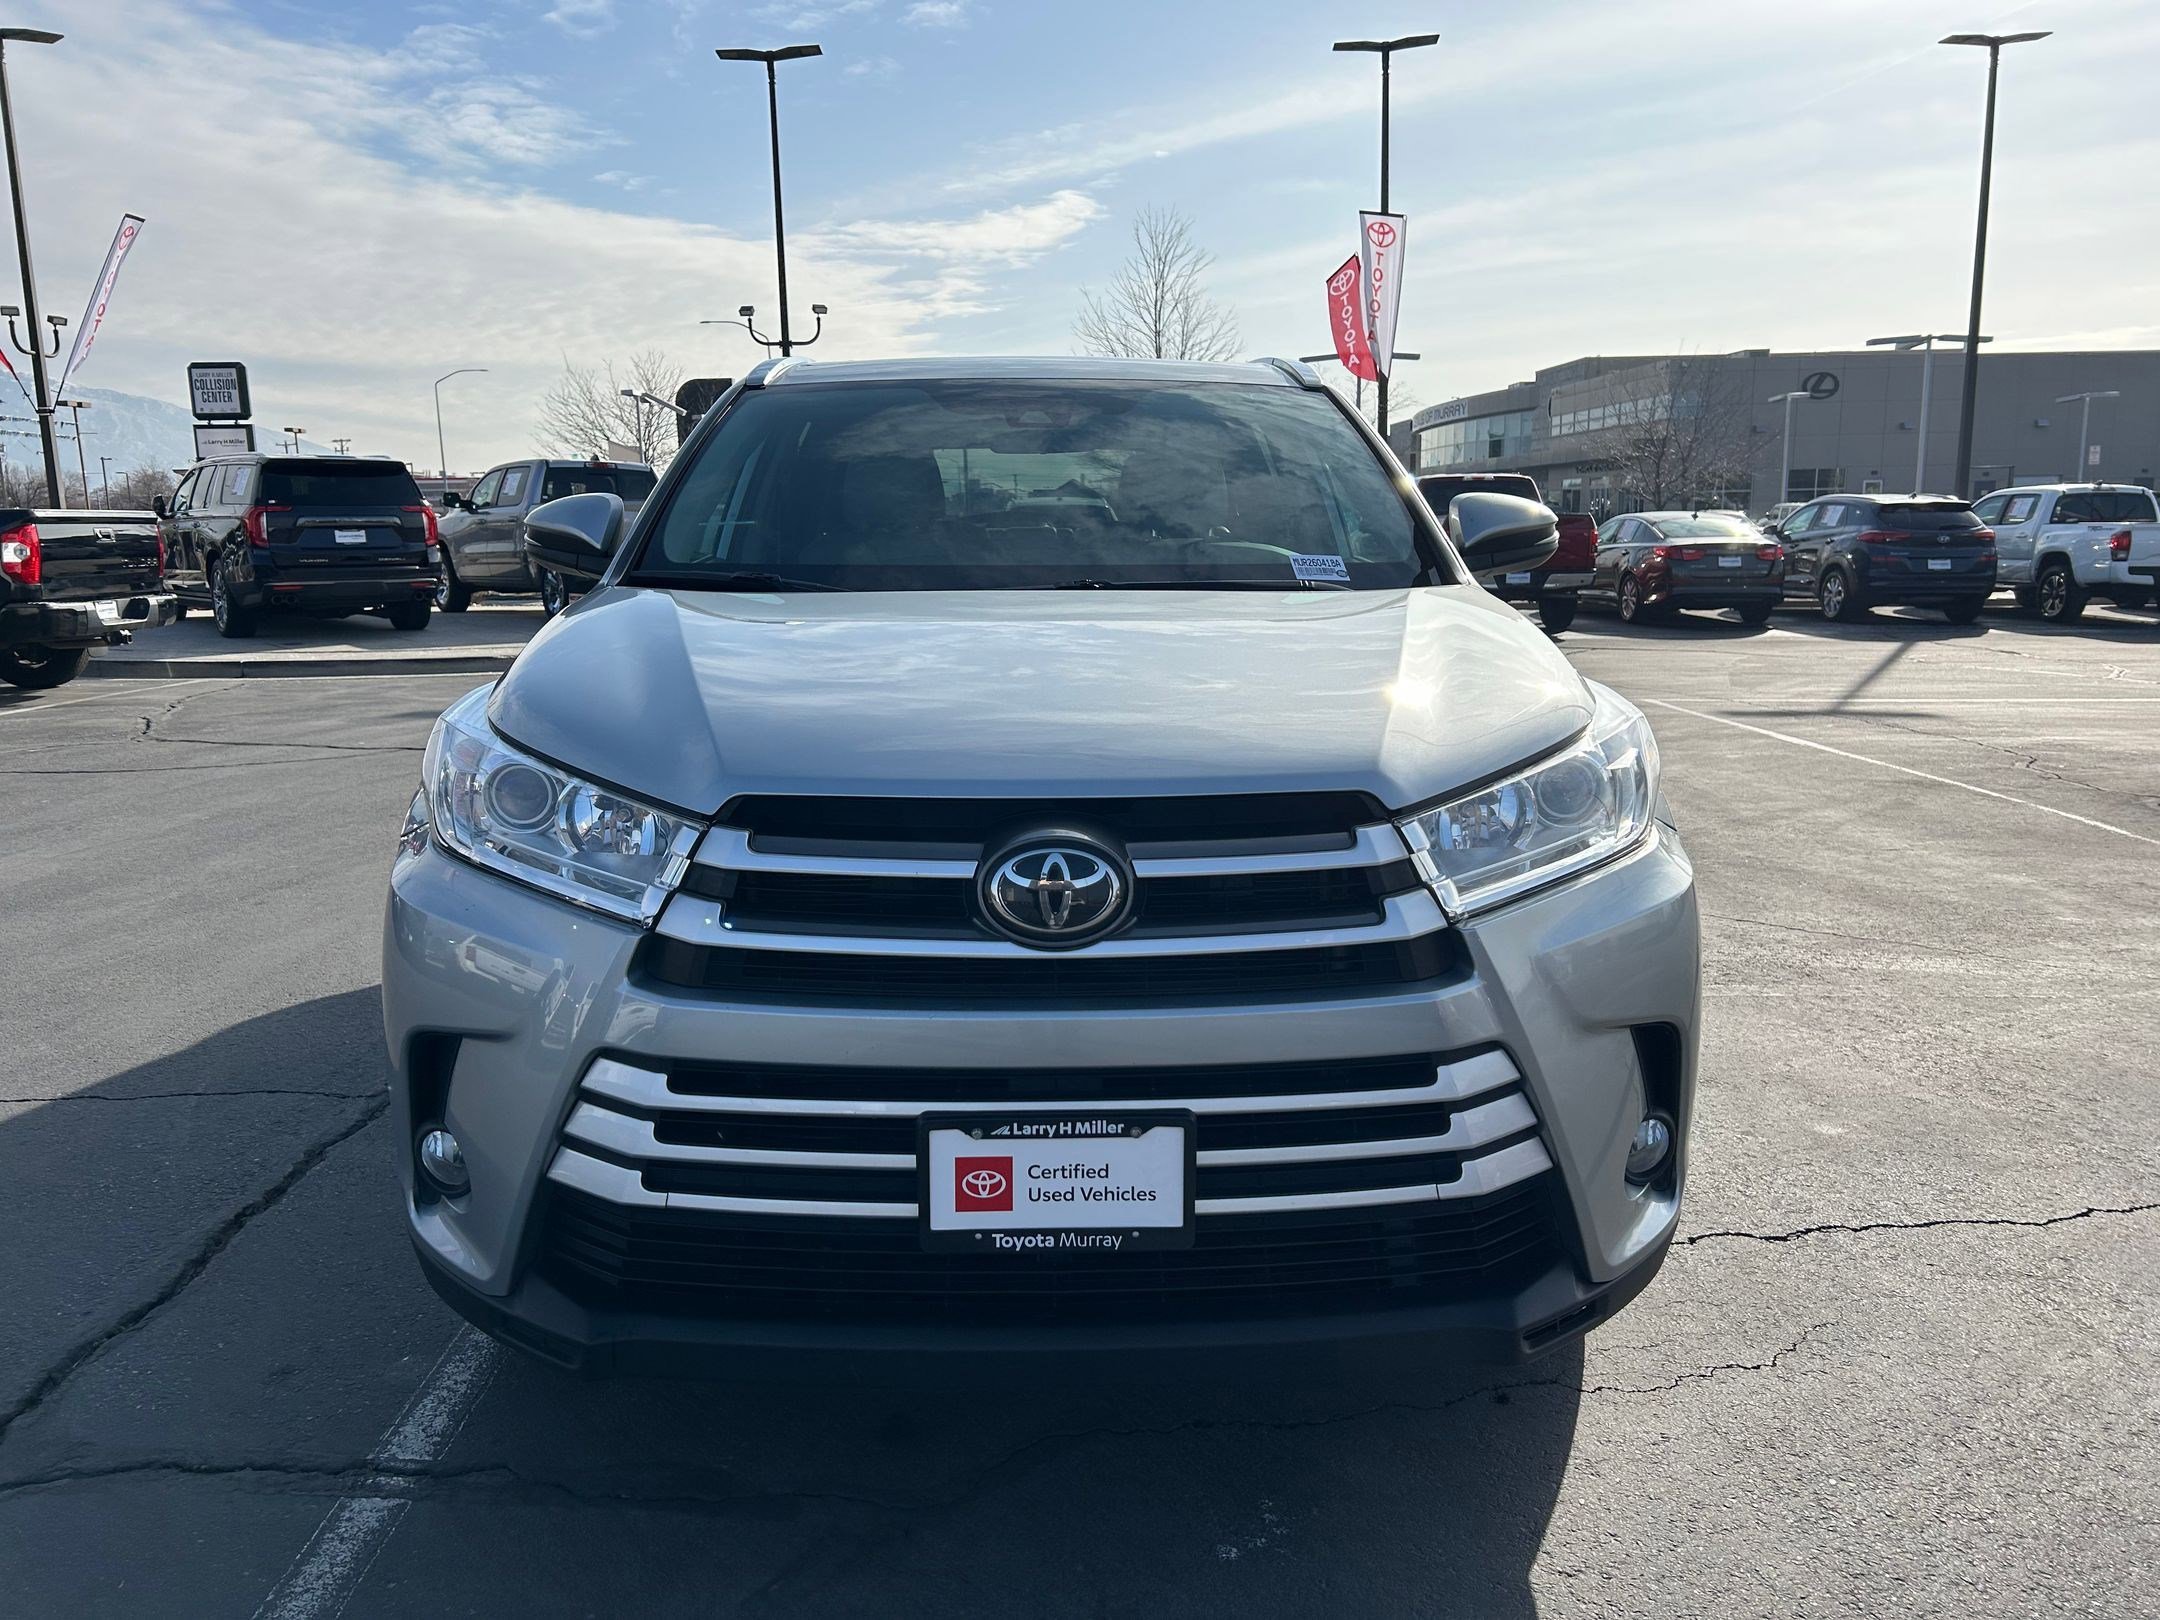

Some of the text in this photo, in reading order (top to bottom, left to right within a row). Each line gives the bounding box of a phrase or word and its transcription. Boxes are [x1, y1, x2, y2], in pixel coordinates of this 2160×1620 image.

[1367, 251, 1383, 341] TOYOTA
[1340, 293, 1359, 368] TOYOTA
[193, 378, 237, 391] COLLISION
[201, 391, 233, 403] CENTER
[1013, 1120, 1124, 1137] Larry H Miller
[1027, 1163, 1109, 1180] Certified
[1028, 1185, 1157, 1202] Used Vehicles
[992, 1232, 1123, 1251] Toyota Murray
